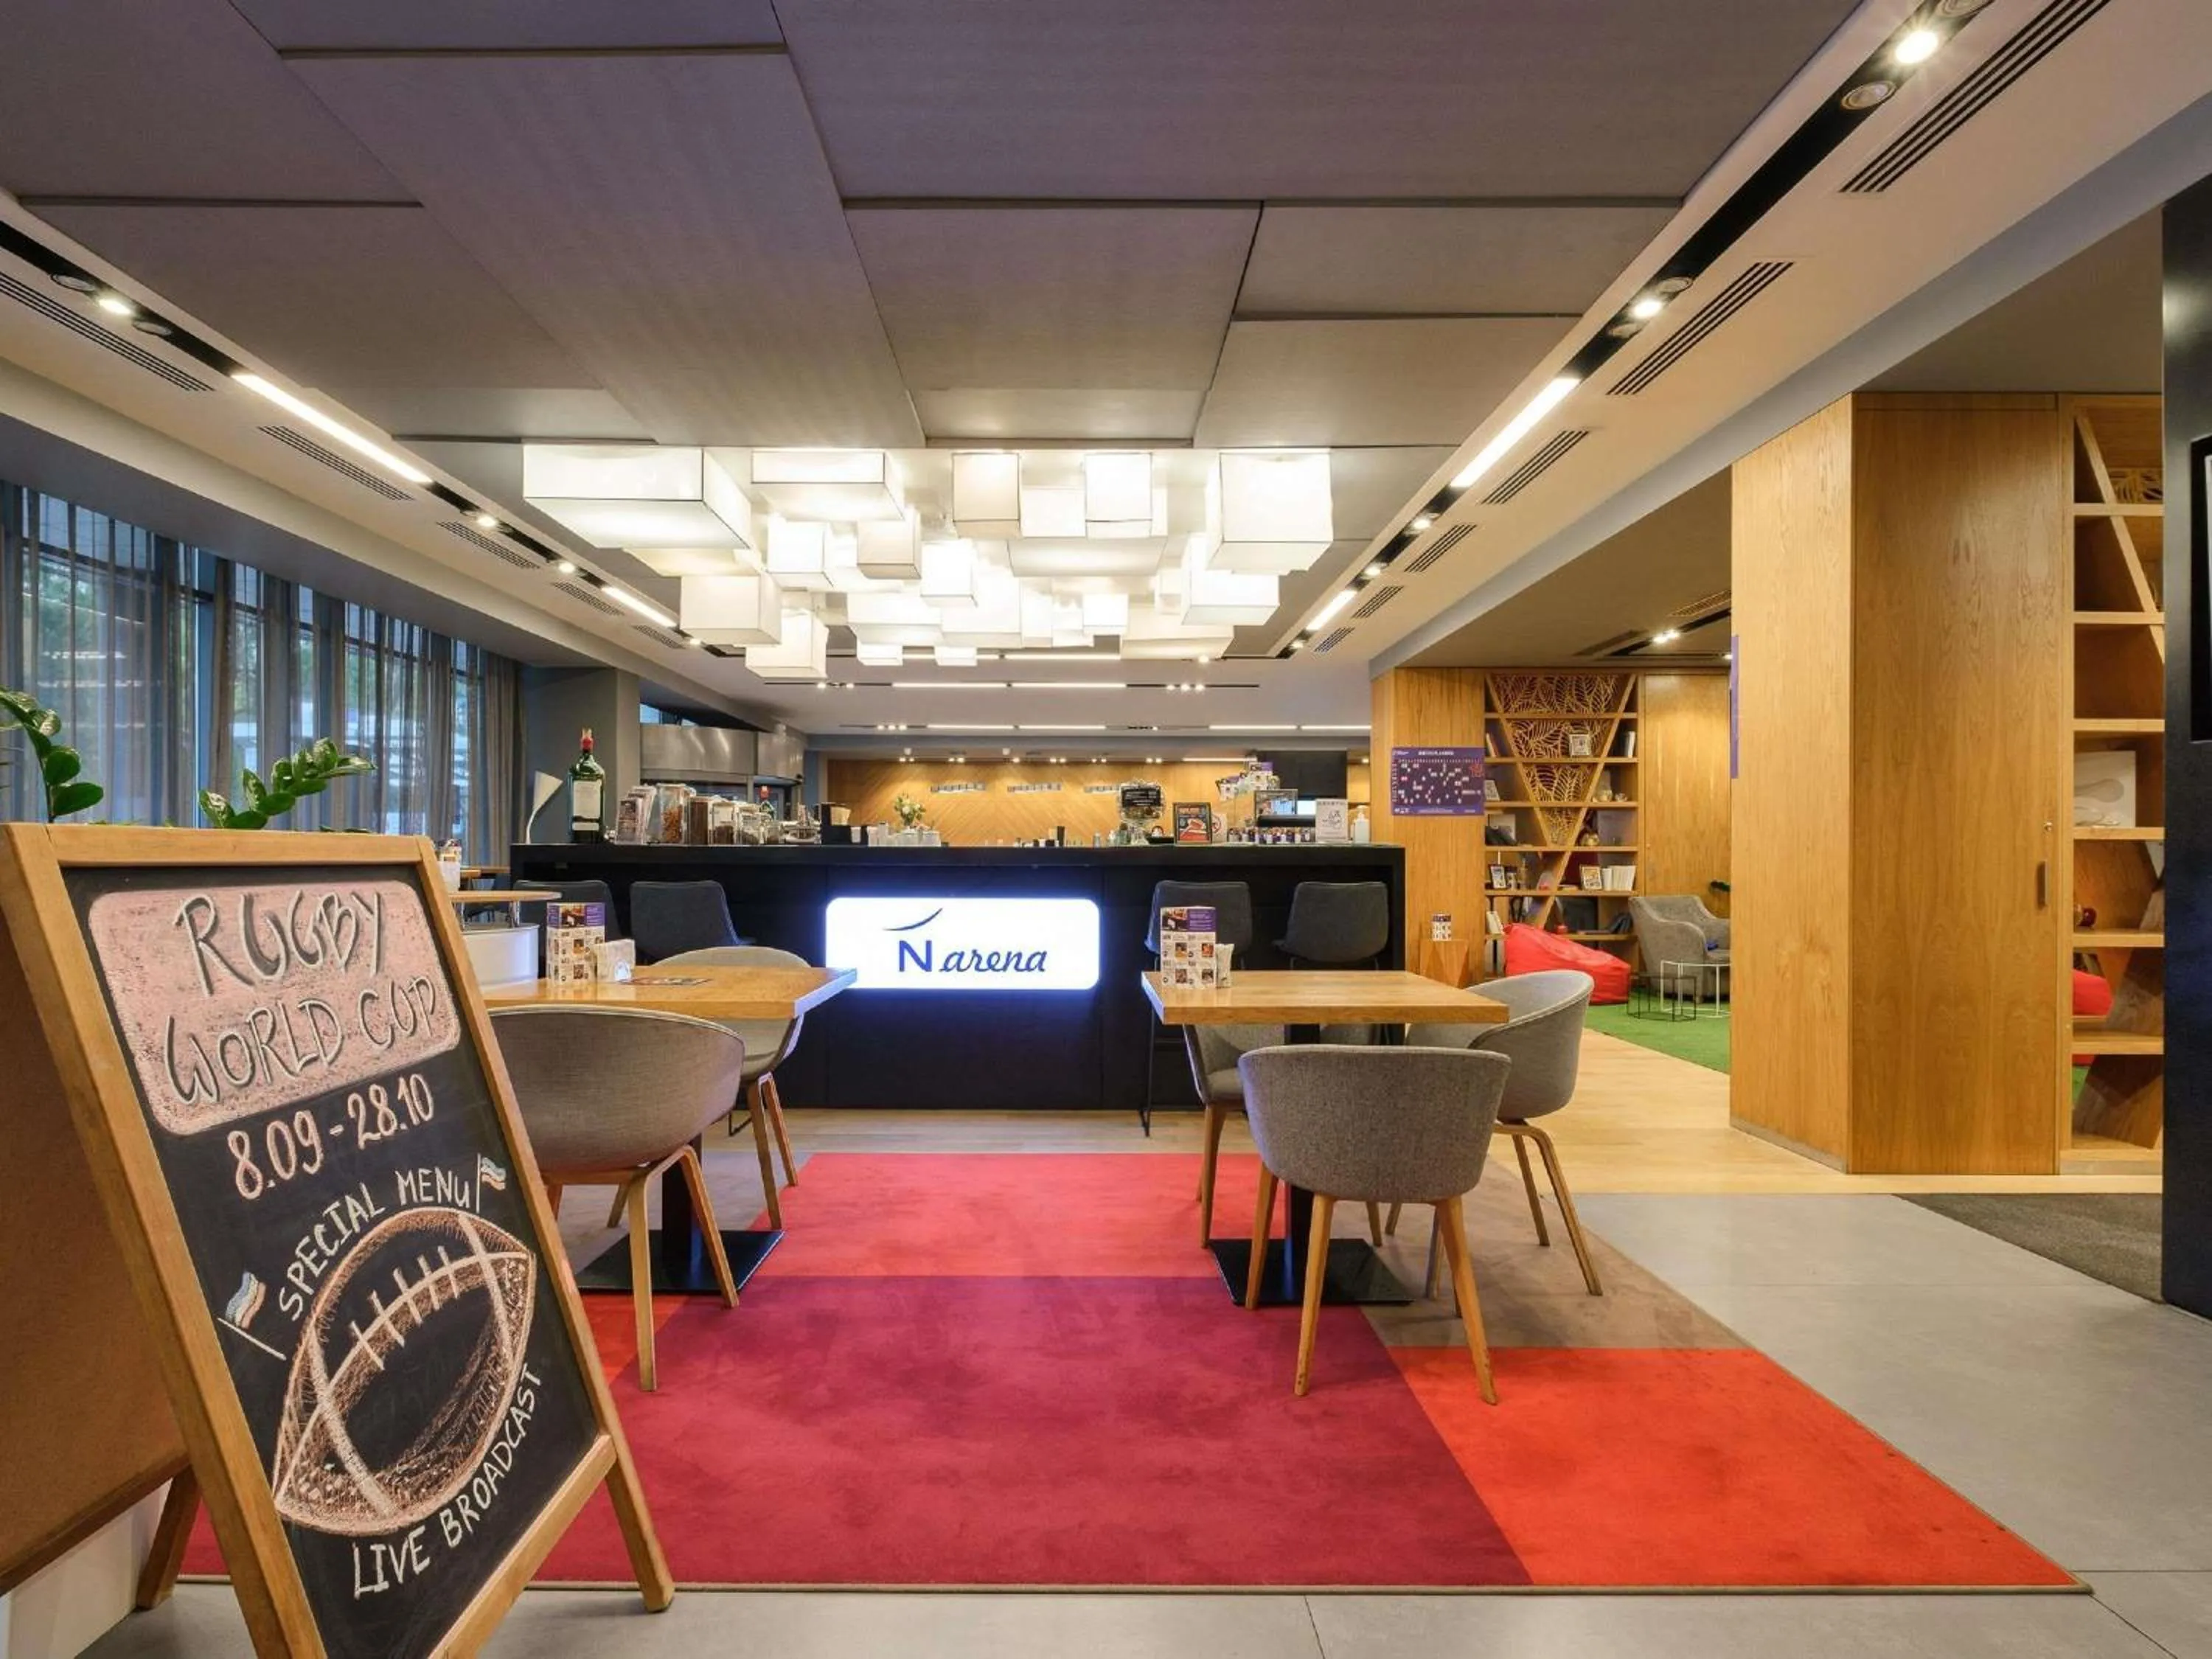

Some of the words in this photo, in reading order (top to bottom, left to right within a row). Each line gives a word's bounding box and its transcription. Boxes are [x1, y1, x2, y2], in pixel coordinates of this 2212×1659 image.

[173, 888, 385, 998] RUGBY
[164, 992, 344, 1107] WORLD
[358, 974, 437, 1051] CUP
[279, 1183, 385, 1321] SPECIAL
[395, 1169, 470, 1209] MENU
[352, 1523, 431, 1601] LIVE
[438, 1362, 543, 1548] BROADCAST
